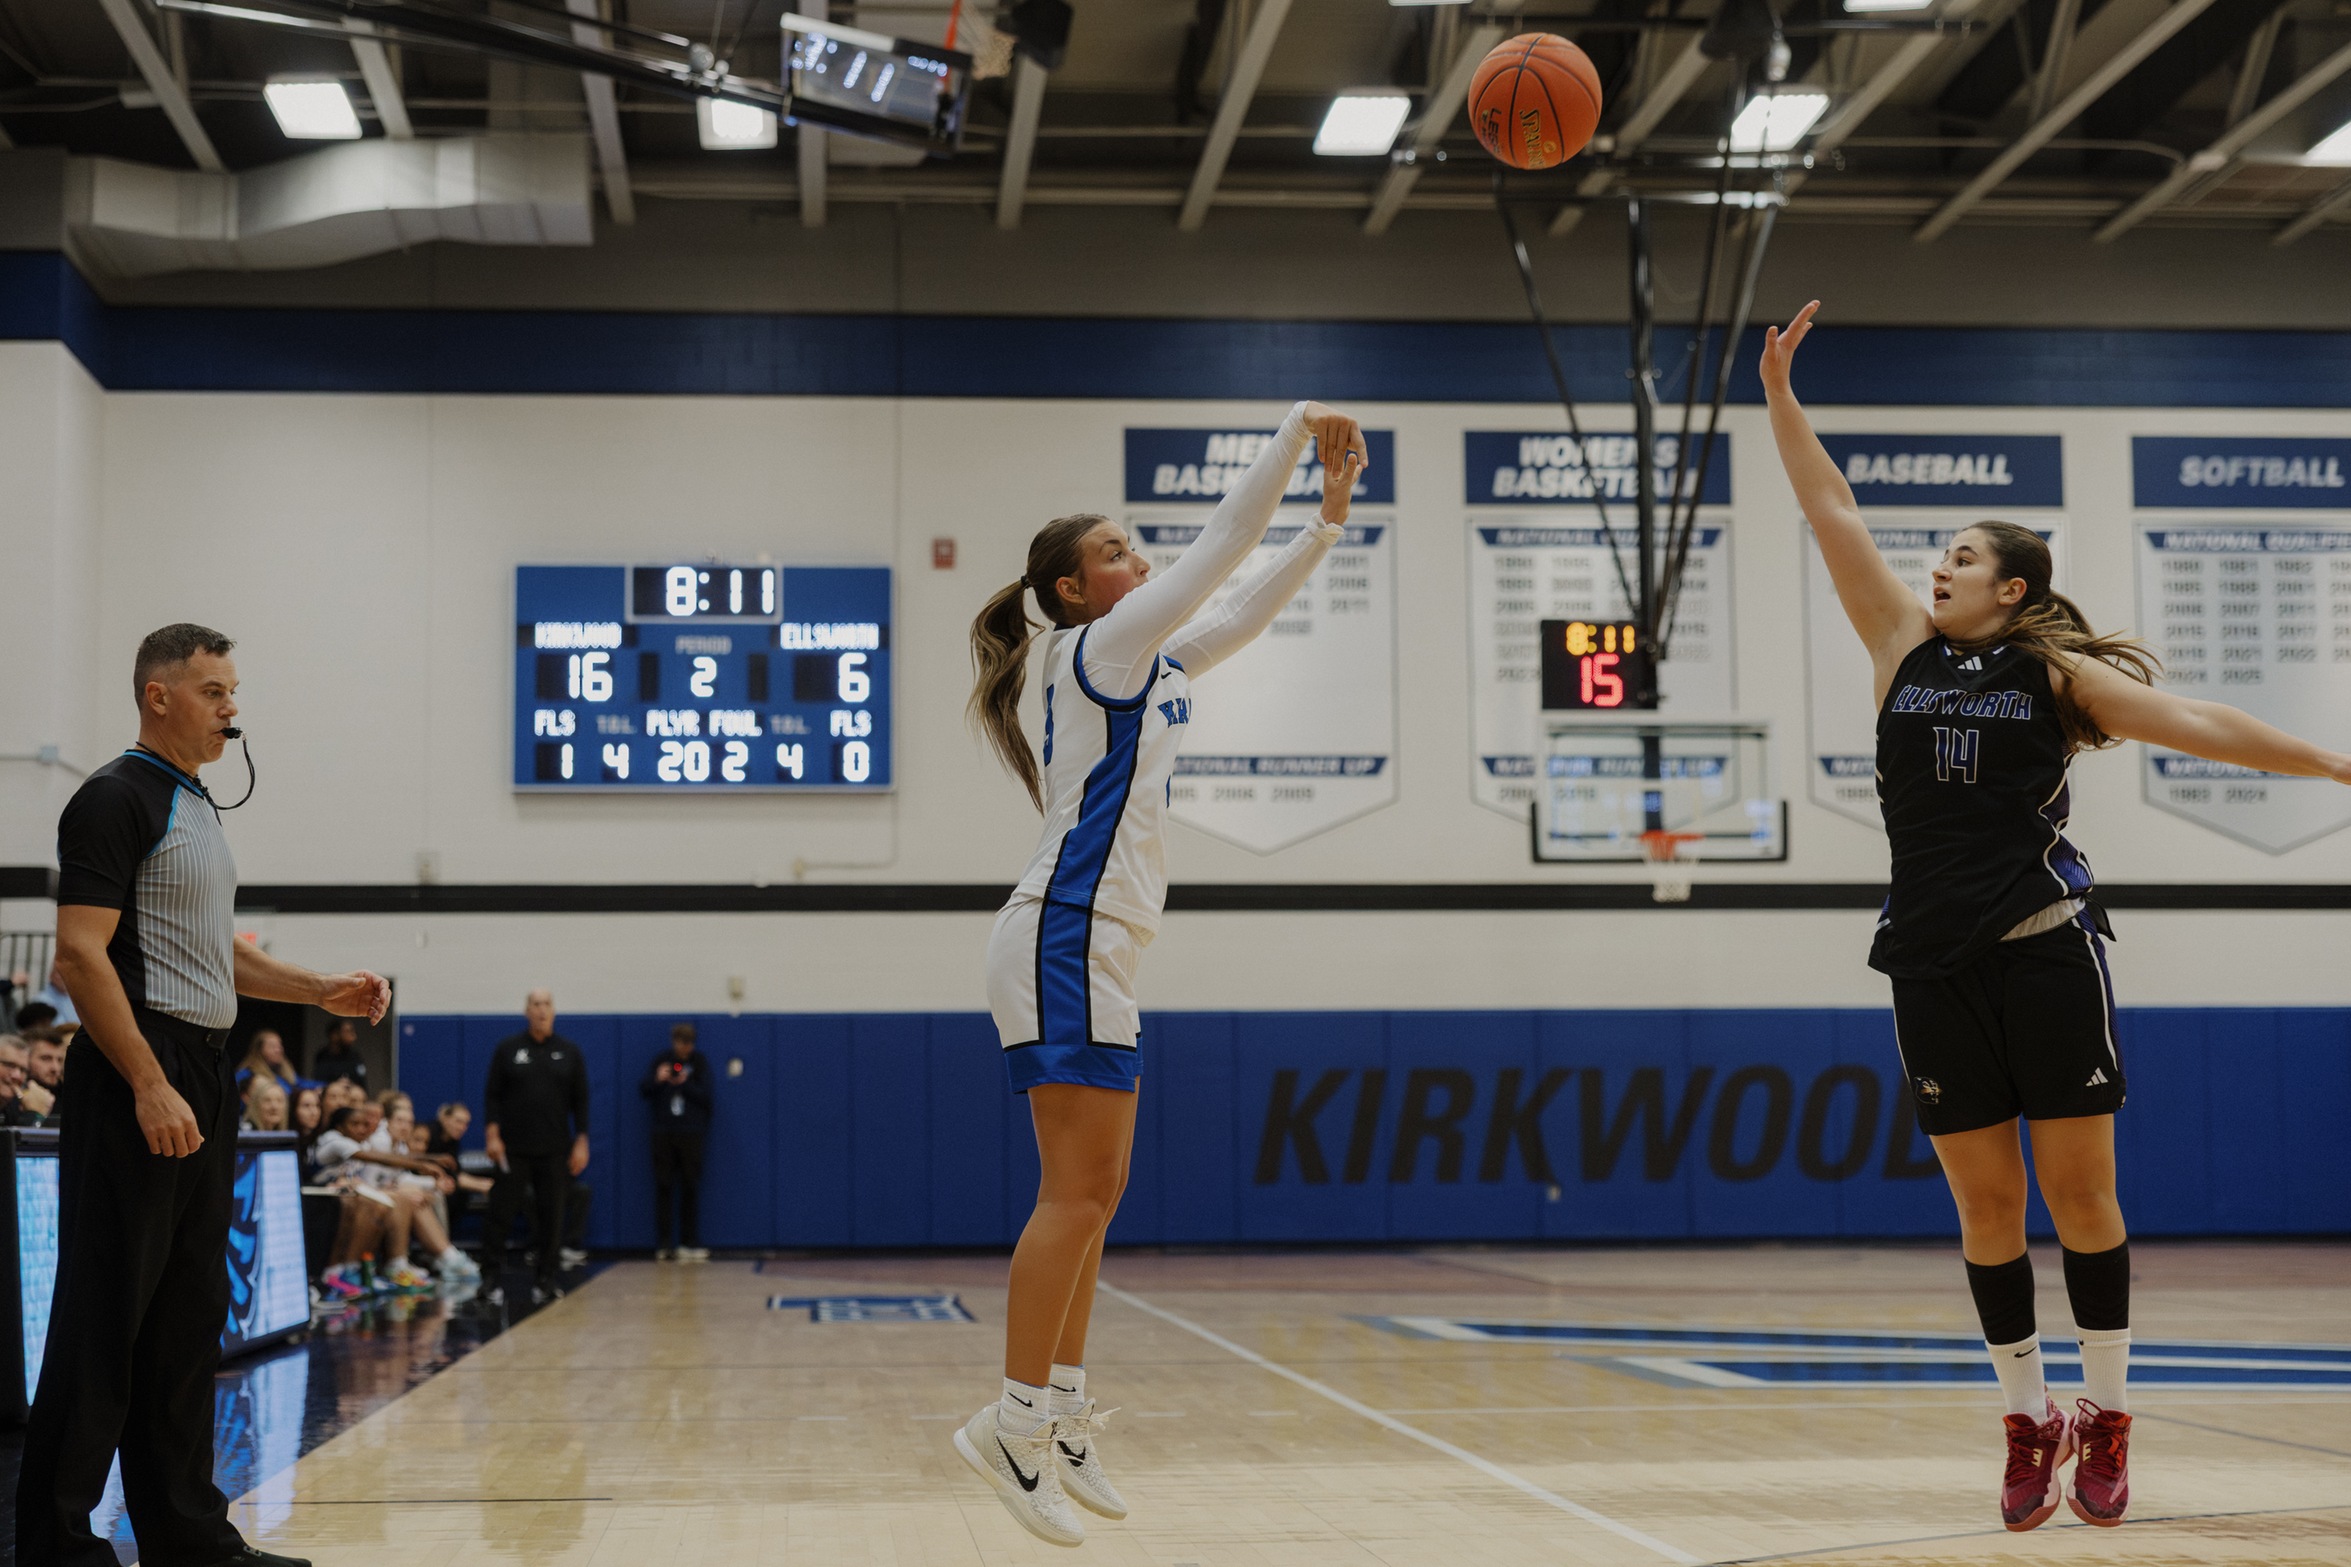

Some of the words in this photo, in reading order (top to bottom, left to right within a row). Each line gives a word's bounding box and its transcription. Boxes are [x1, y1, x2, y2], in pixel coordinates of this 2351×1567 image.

[1845, 453, 2013, 486] BASEBALL
[2179, 455, 2346, 488] SOFTBALL
[666, 566, 774, 616] 8:11
[676, 635, 731, 655] PERIOD
[1566, 622, 1635, 655] 8:11
[569, 652, 613, 701] 16
[690, 657, 717, 697] 2
[838, 653, 870, 702] 6
[1581, 653, 1623, 707] 15
[1892, 684, 2033, 720] ELLSWORTH
[534, 710, 575, 736] FLS
[647, 710, 700, 736] PLYR
[709, 710, 762, 736] FOUL
[830, 710, 872, 736] FLS
[561, 743, 574, 779] 1
[603, 743, 629, 779] 4
[658, 741, 710, 782] 20
[722, 741, 749, 782] 2
[777, 743, 803, 779] 4
[843, 741, 870, 782] 0
[1932, 727, 1980, 784] 14
